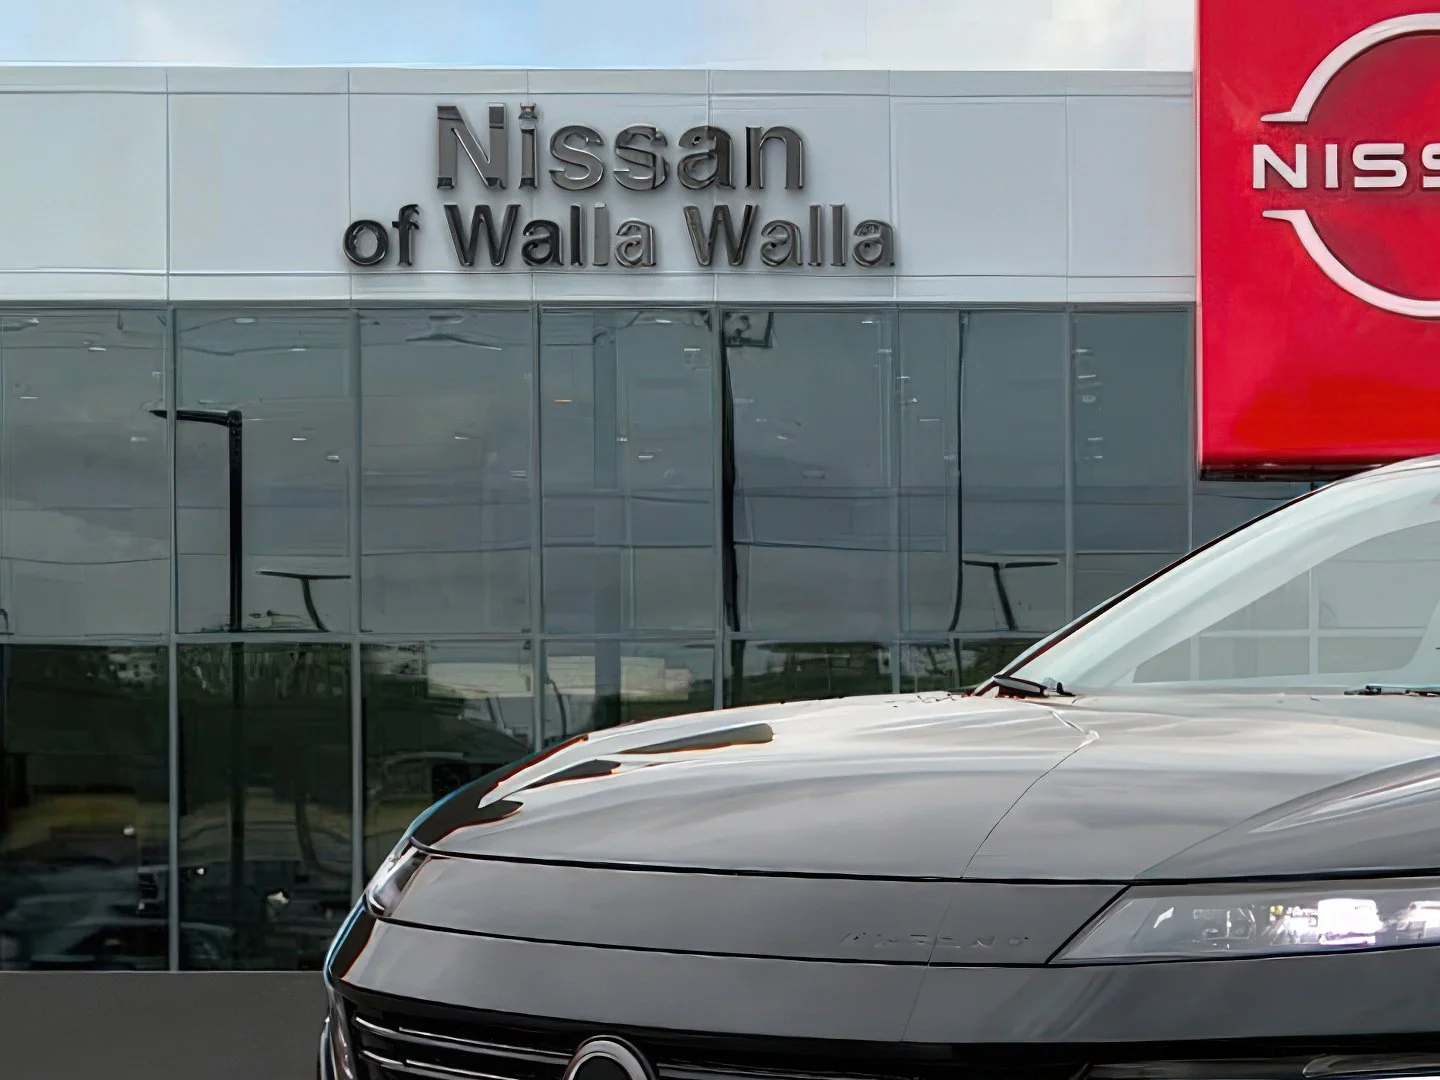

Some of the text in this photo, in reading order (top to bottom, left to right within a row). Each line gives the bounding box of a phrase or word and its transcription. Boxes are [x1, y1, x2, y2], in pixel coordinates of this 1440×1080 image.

[437, 102, 804, 191] Nissan
[342, 203, 896, 268] of Walla Walla
